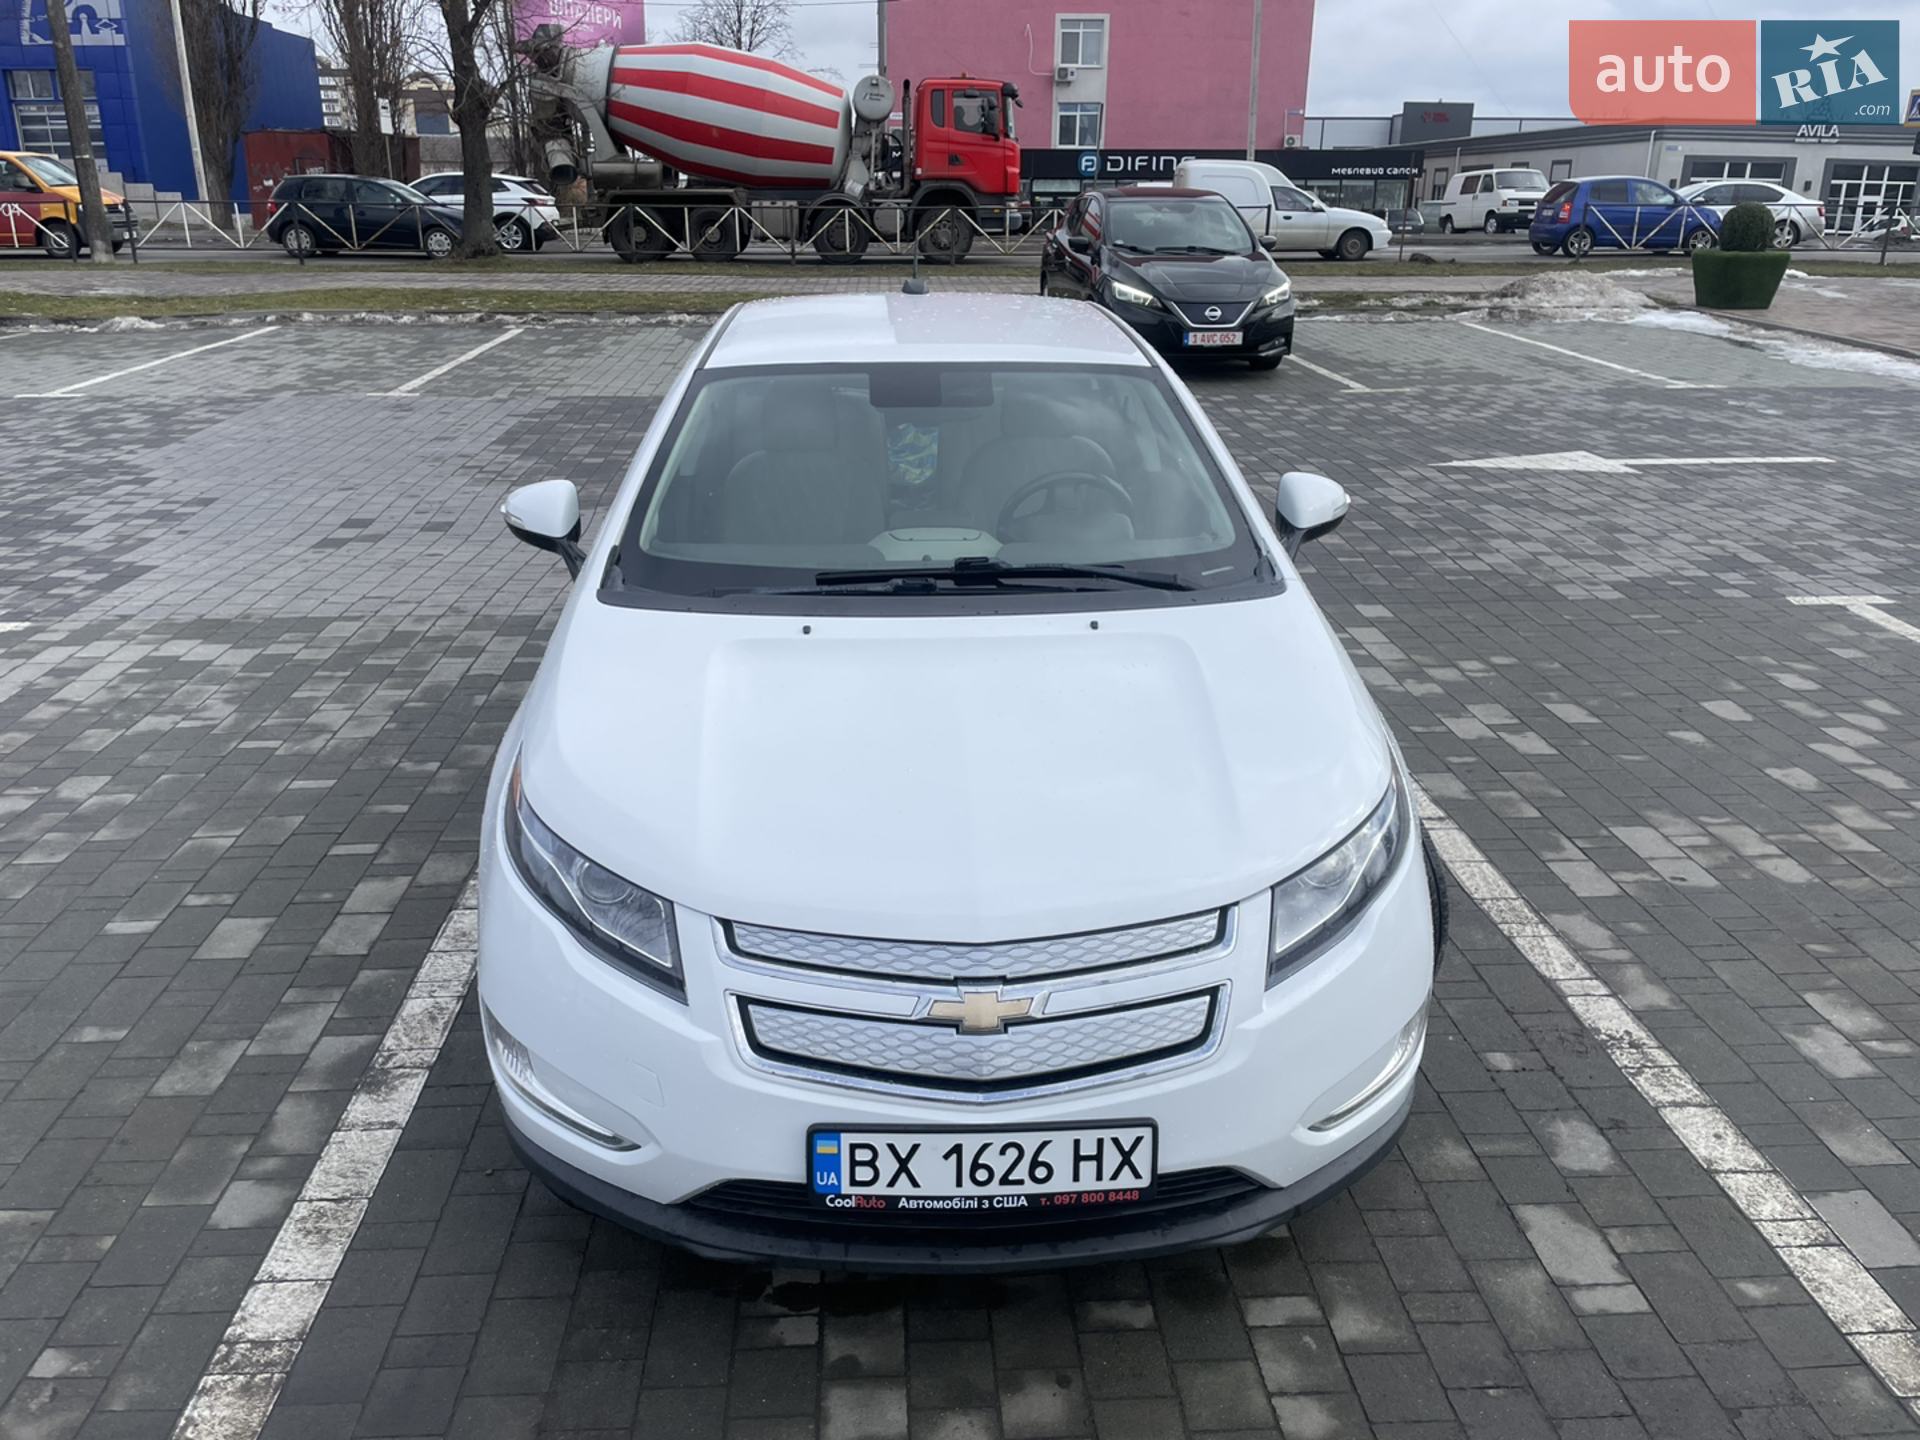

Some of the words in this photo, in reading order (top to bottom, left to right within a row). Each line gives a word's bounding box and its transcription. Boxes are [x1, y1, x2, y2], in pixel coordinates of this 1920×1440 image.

[1797, 125, 1840, 137] AVILA
[849, 1143, 921, 1188] BX
[942, 1140, 1054, 1187] 1626
[1072, 1136, 1144, 1183] HX
[816, 1171, 838, 1186] UA
[826, 1195, 886, 1208] CoolAuto
[898, 1197, 978, 1209] Автомобілі
[981, 1199, 989, 1208] з
[993, 1196, 1028, 1208] США
[1054, 1194, 1077, 1205] 097
[1081, 1192, 1104, 1204] 800
[1108, 1190, 1139, 1202] 8448
